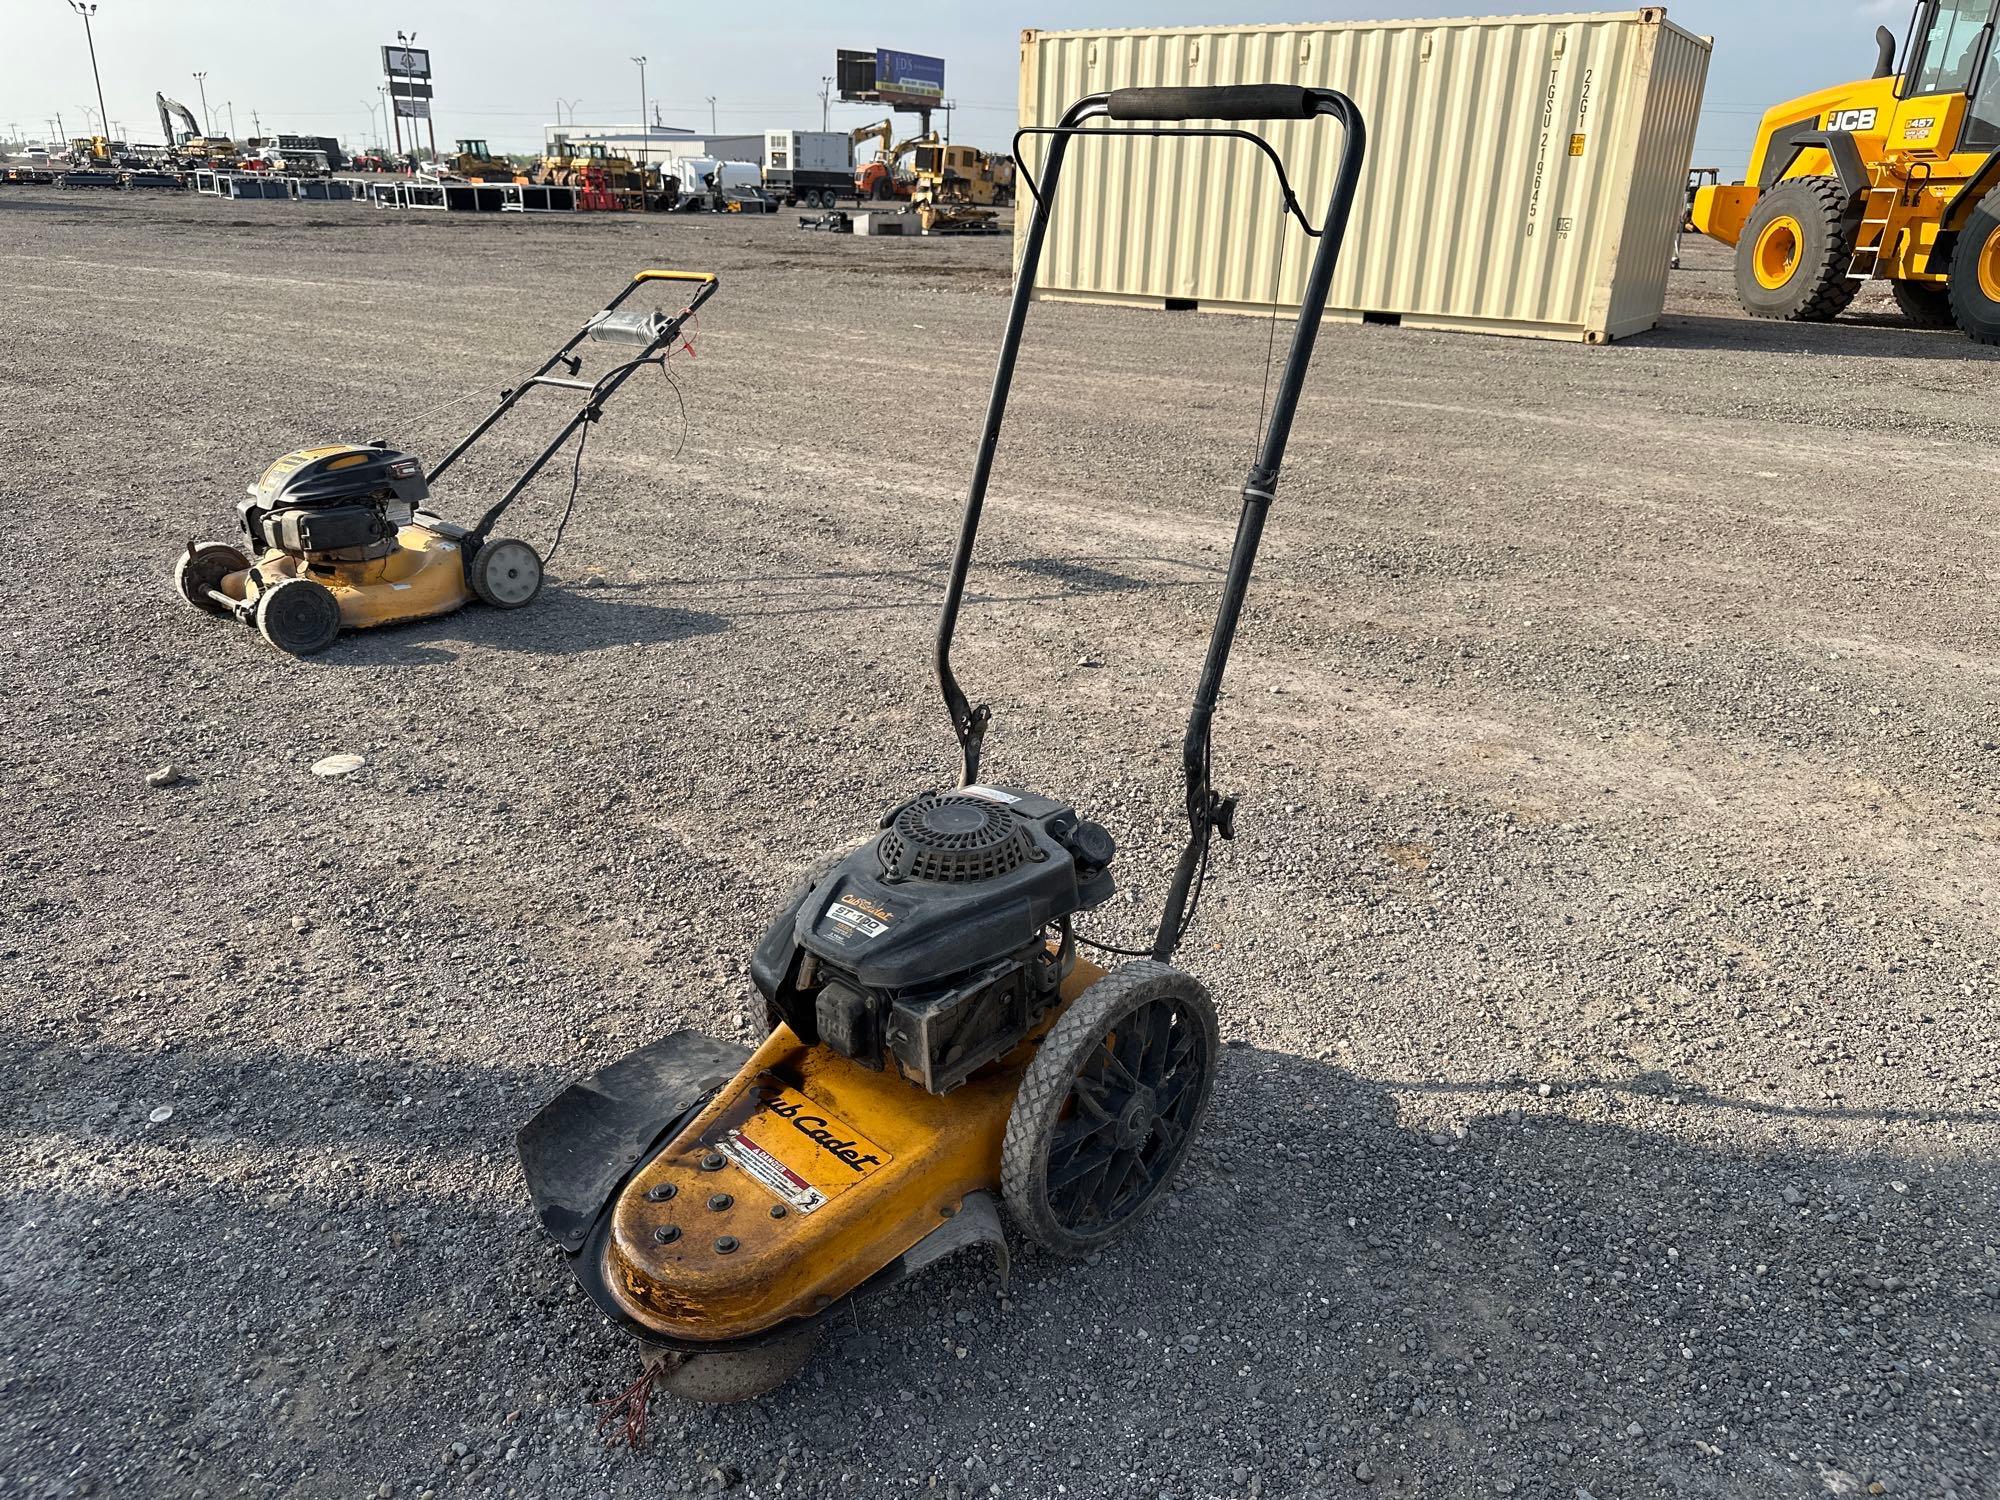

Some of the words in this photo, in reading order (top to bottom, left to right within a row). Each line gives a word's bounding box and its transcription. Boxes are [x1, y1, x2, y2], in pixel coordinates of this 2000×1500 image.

[1543, 69, 1559, 128] TGSU
[1579, 69, 1593, 128] 22G1
[1827, 108, 1876, 131] JCB
[1529, 132, 1548, 217] 219645
[760, 1150, 787, 1173] DANGER
[764, 1096, 804, 1118] ub
[792, 1115, 881, 1172] Cadet
